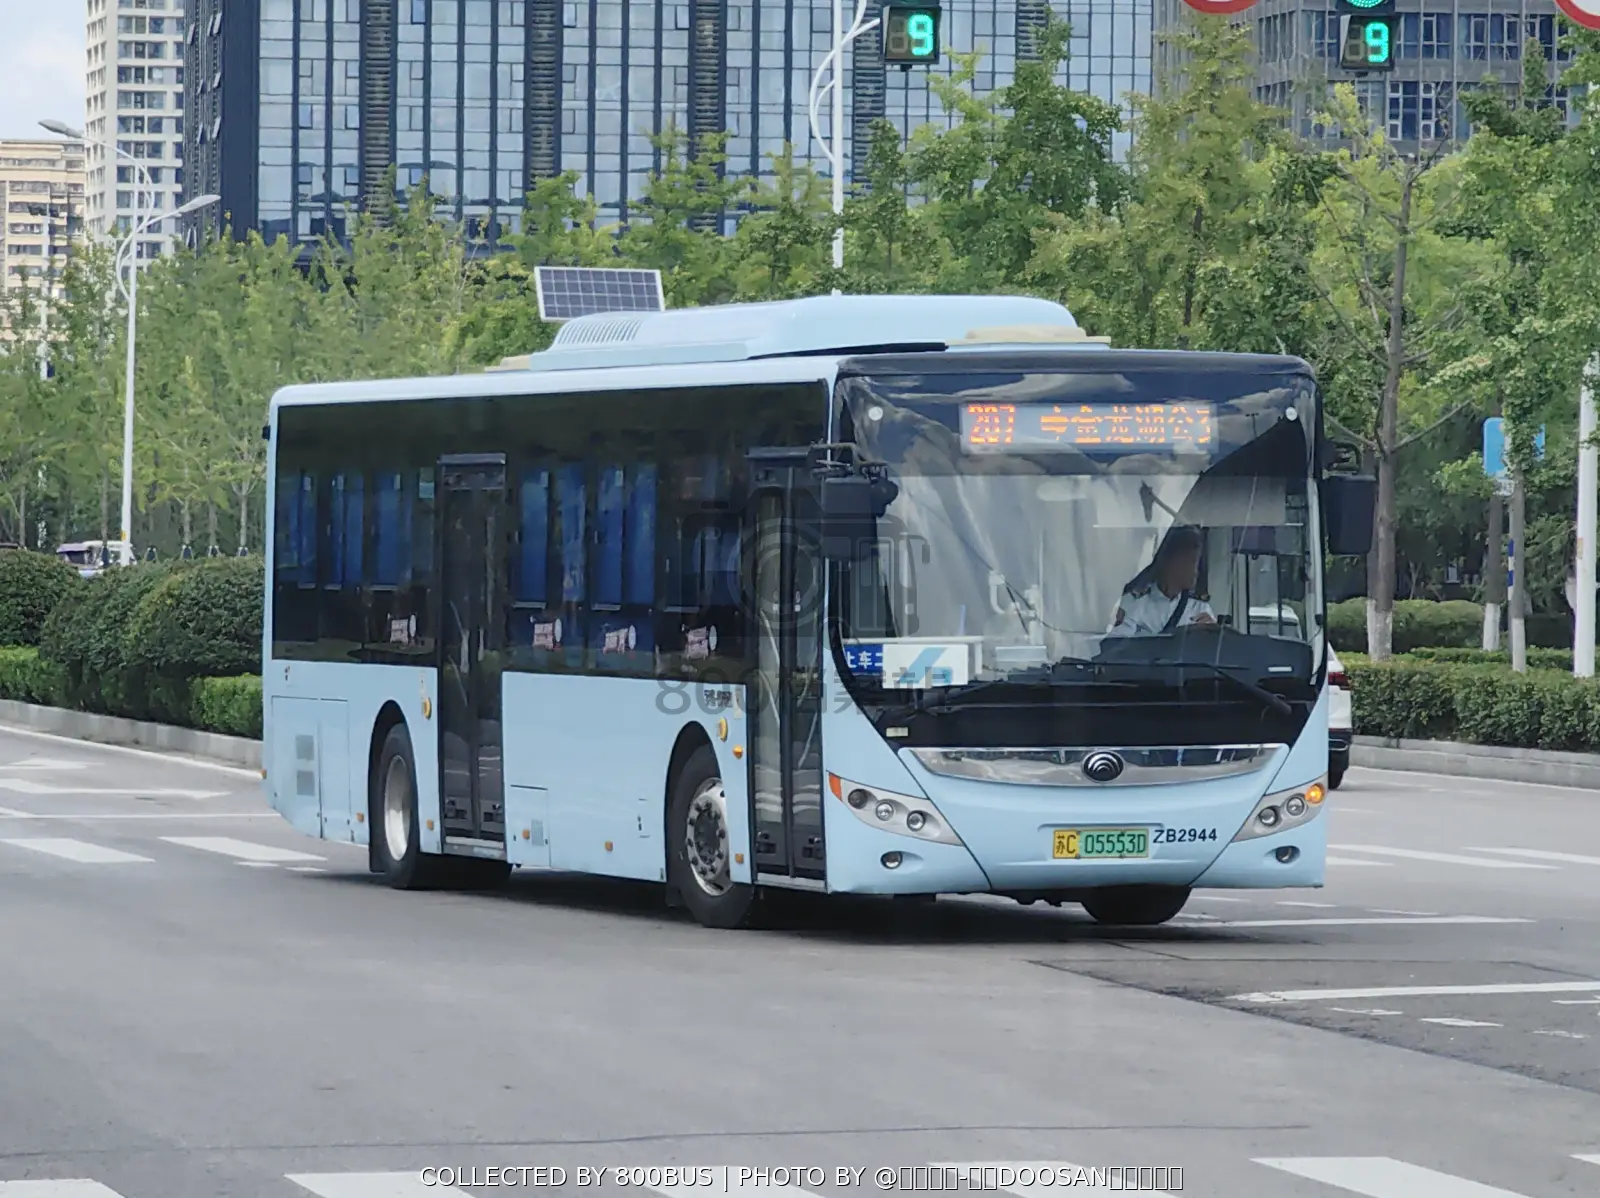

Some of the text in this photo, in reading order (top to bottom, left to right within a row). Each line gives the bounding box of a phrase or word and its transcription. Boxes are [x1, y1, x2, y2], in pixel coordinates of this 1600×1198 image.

[908, 14, 934, 56] 9
[1365, 22, 1389, 62] 9
[968, 404, 1016, 445] 207
[1153, 827, 1218, 844] ZB2944
